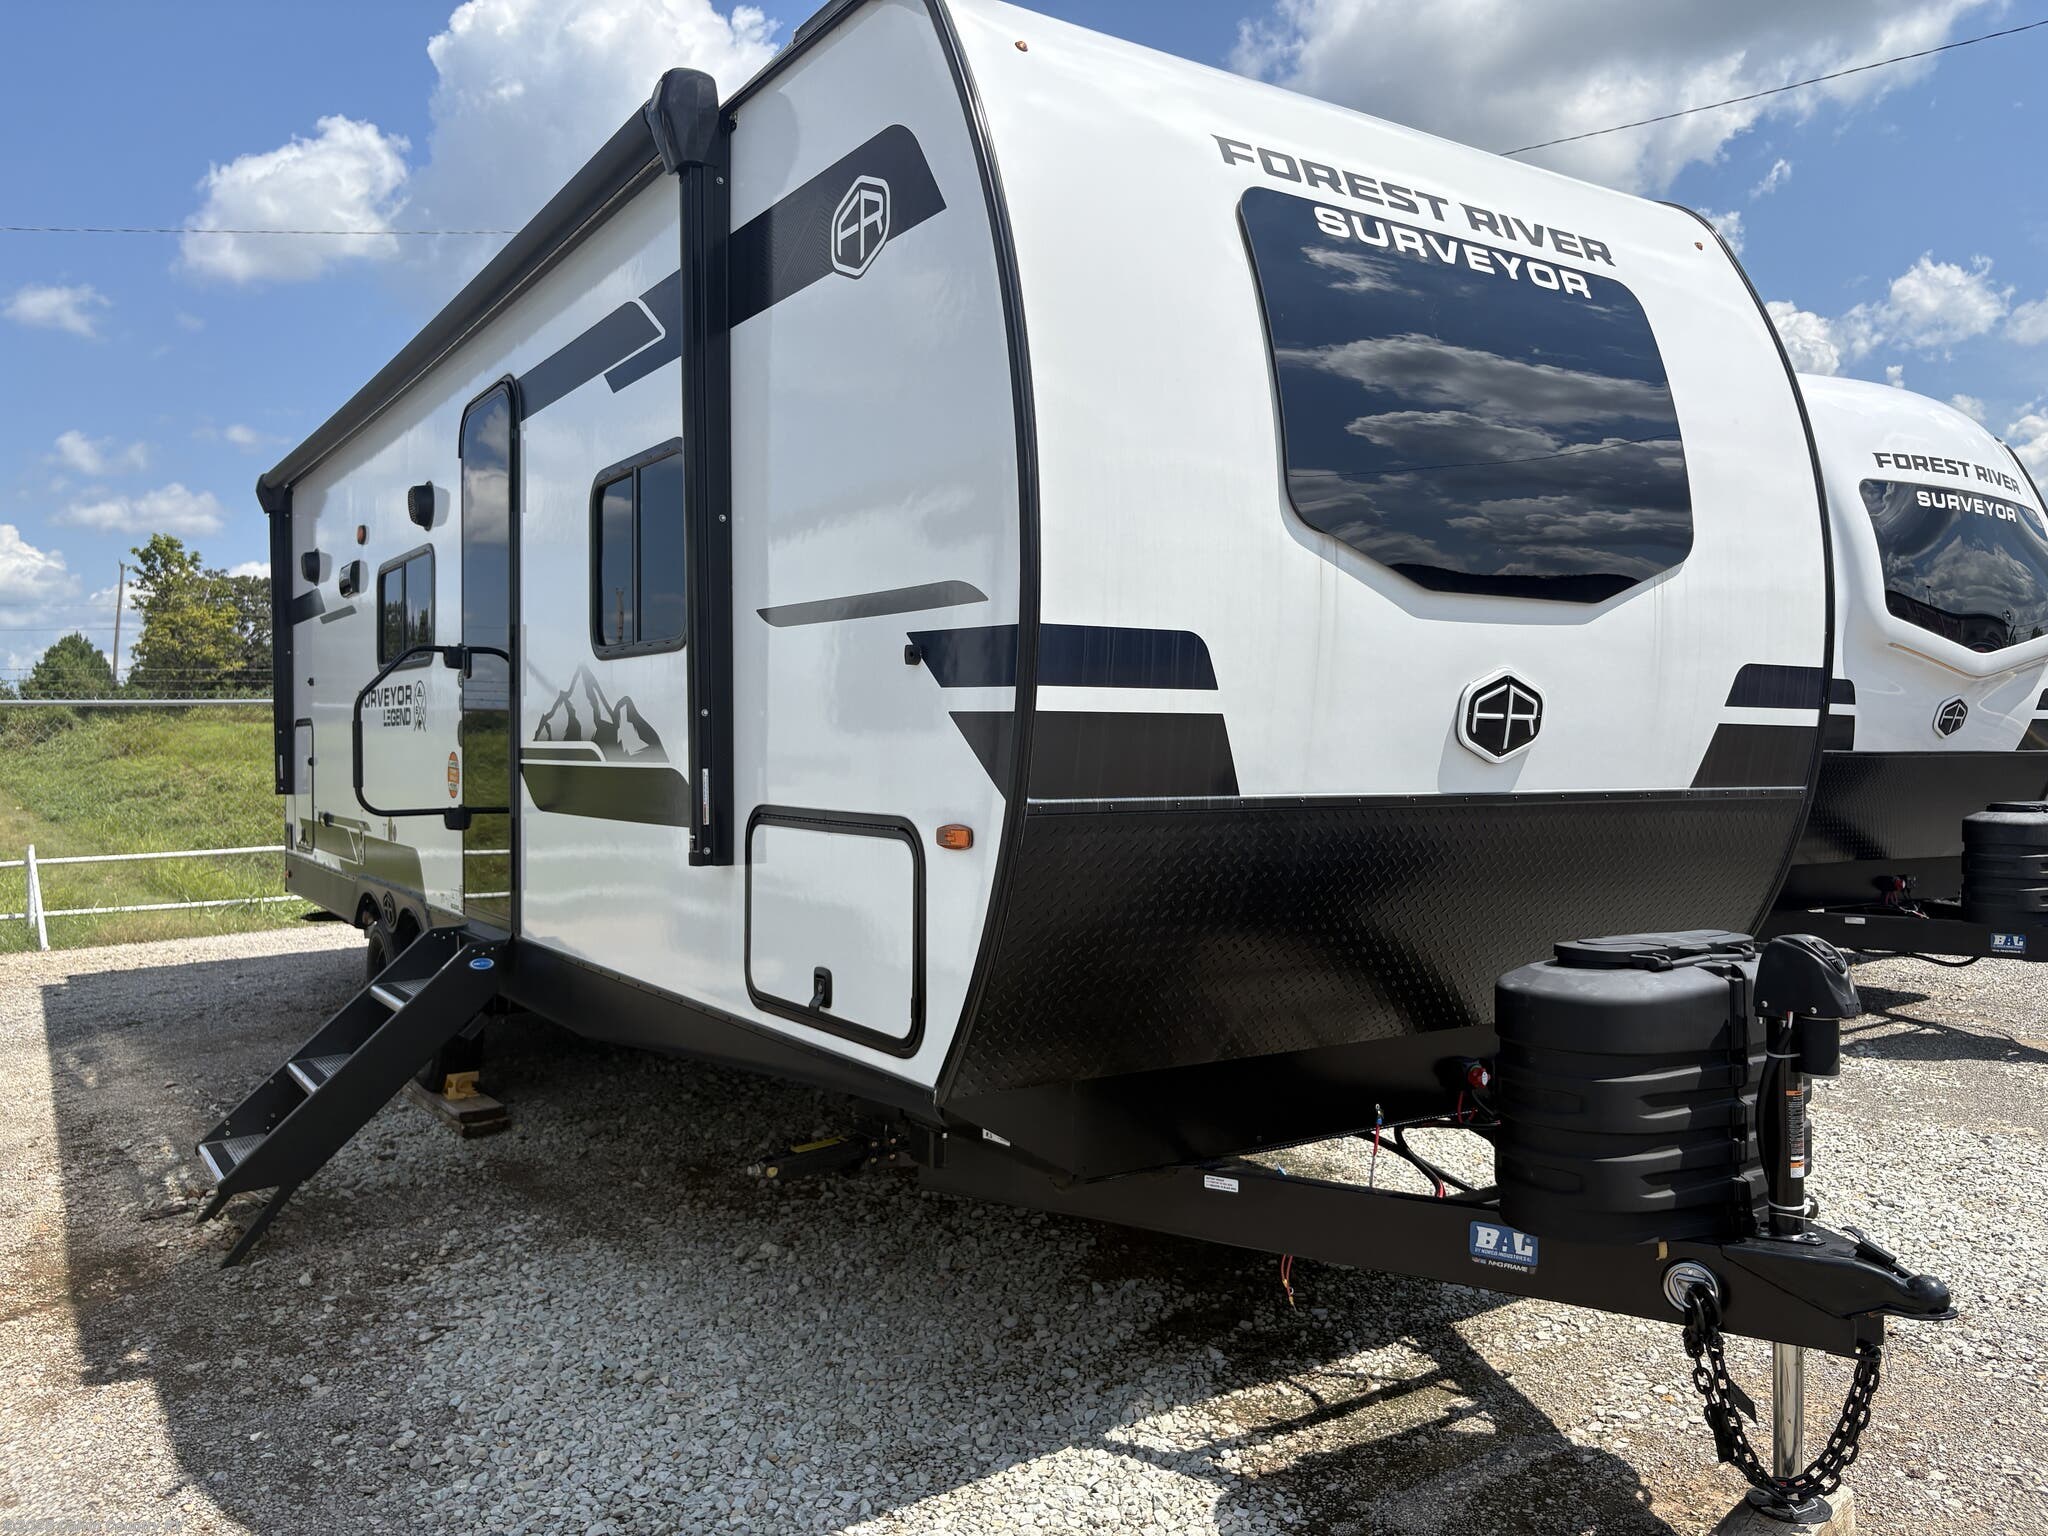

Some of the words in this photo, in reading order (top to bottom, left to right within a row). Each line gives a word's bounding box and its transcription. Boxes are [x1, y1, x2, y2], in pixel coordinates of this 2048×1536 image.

[1211, 134, 1449, 221] FOREST
[1459, 202, 1616, 266] RIVER
[1314, 206, 1592, 299] SURVEYOR
[1872, 452, 1970, 477] FOREST
[1973, 464, 2021, 495] RIVER
[1916, 491, 2017, 523] SURVEYOR
[360, 685, 412, 708] URVEYOR
[384, 707, 411, 727] LEGEND
[1476, 1226, 1533, 1256] BAL
